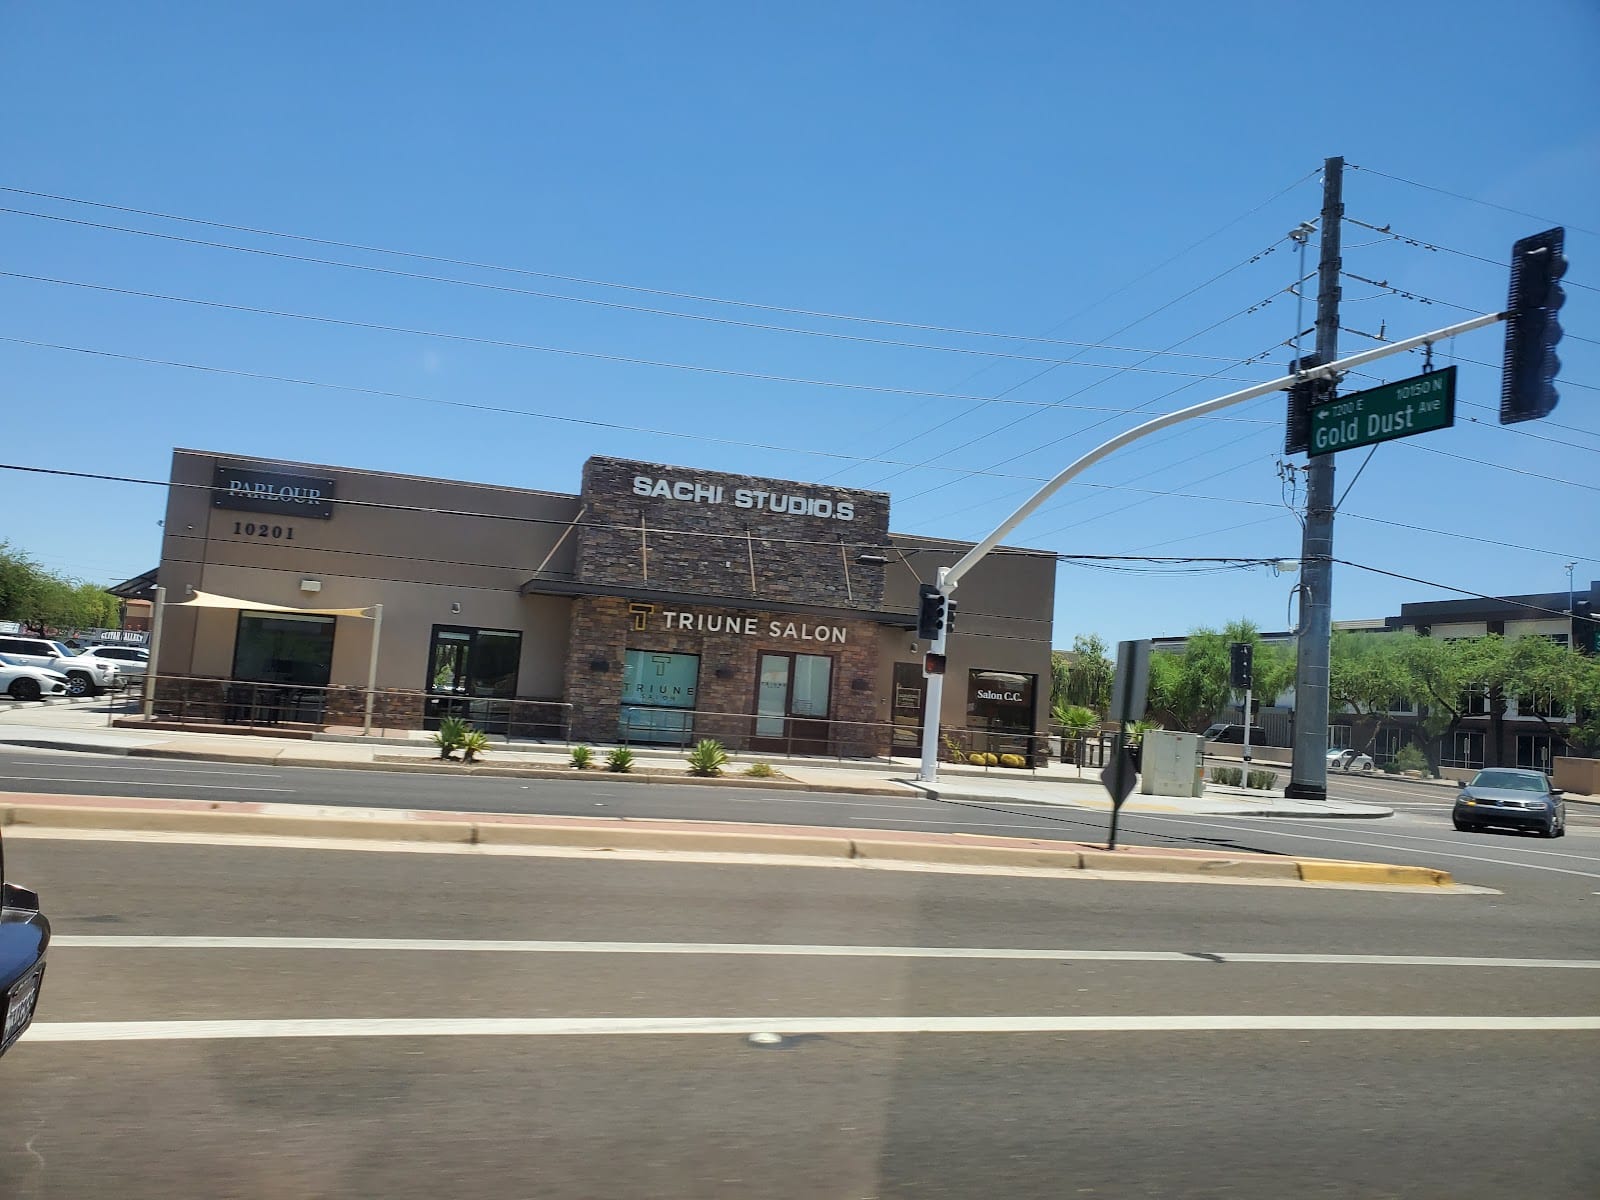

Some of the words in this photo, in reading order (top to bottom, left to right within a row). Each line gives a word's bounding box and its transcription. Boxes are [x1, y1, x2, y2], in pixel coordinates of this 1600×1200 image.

[1432, 378, 1443, 391] N
[1356, 399, 1364, 411] E
[1316, 417, 1359, 448] Gold
[1368, 405, 1414, 437] Dust
[1418, 399, 1441, 414] Ave
[228, 480, 321, 505] PARLOUR
[633, 476, 722, 504] SACHI
[234, 522, 294, 539] 10201
[663, 611, 758, 636] TRIUNE
[769, 621, 847, 644] SALON
[623, 683, 695, 696] TRIUNE
[977, 690, 1003, 700] Salon
[1004, 692, 1022, 701] C.C.
